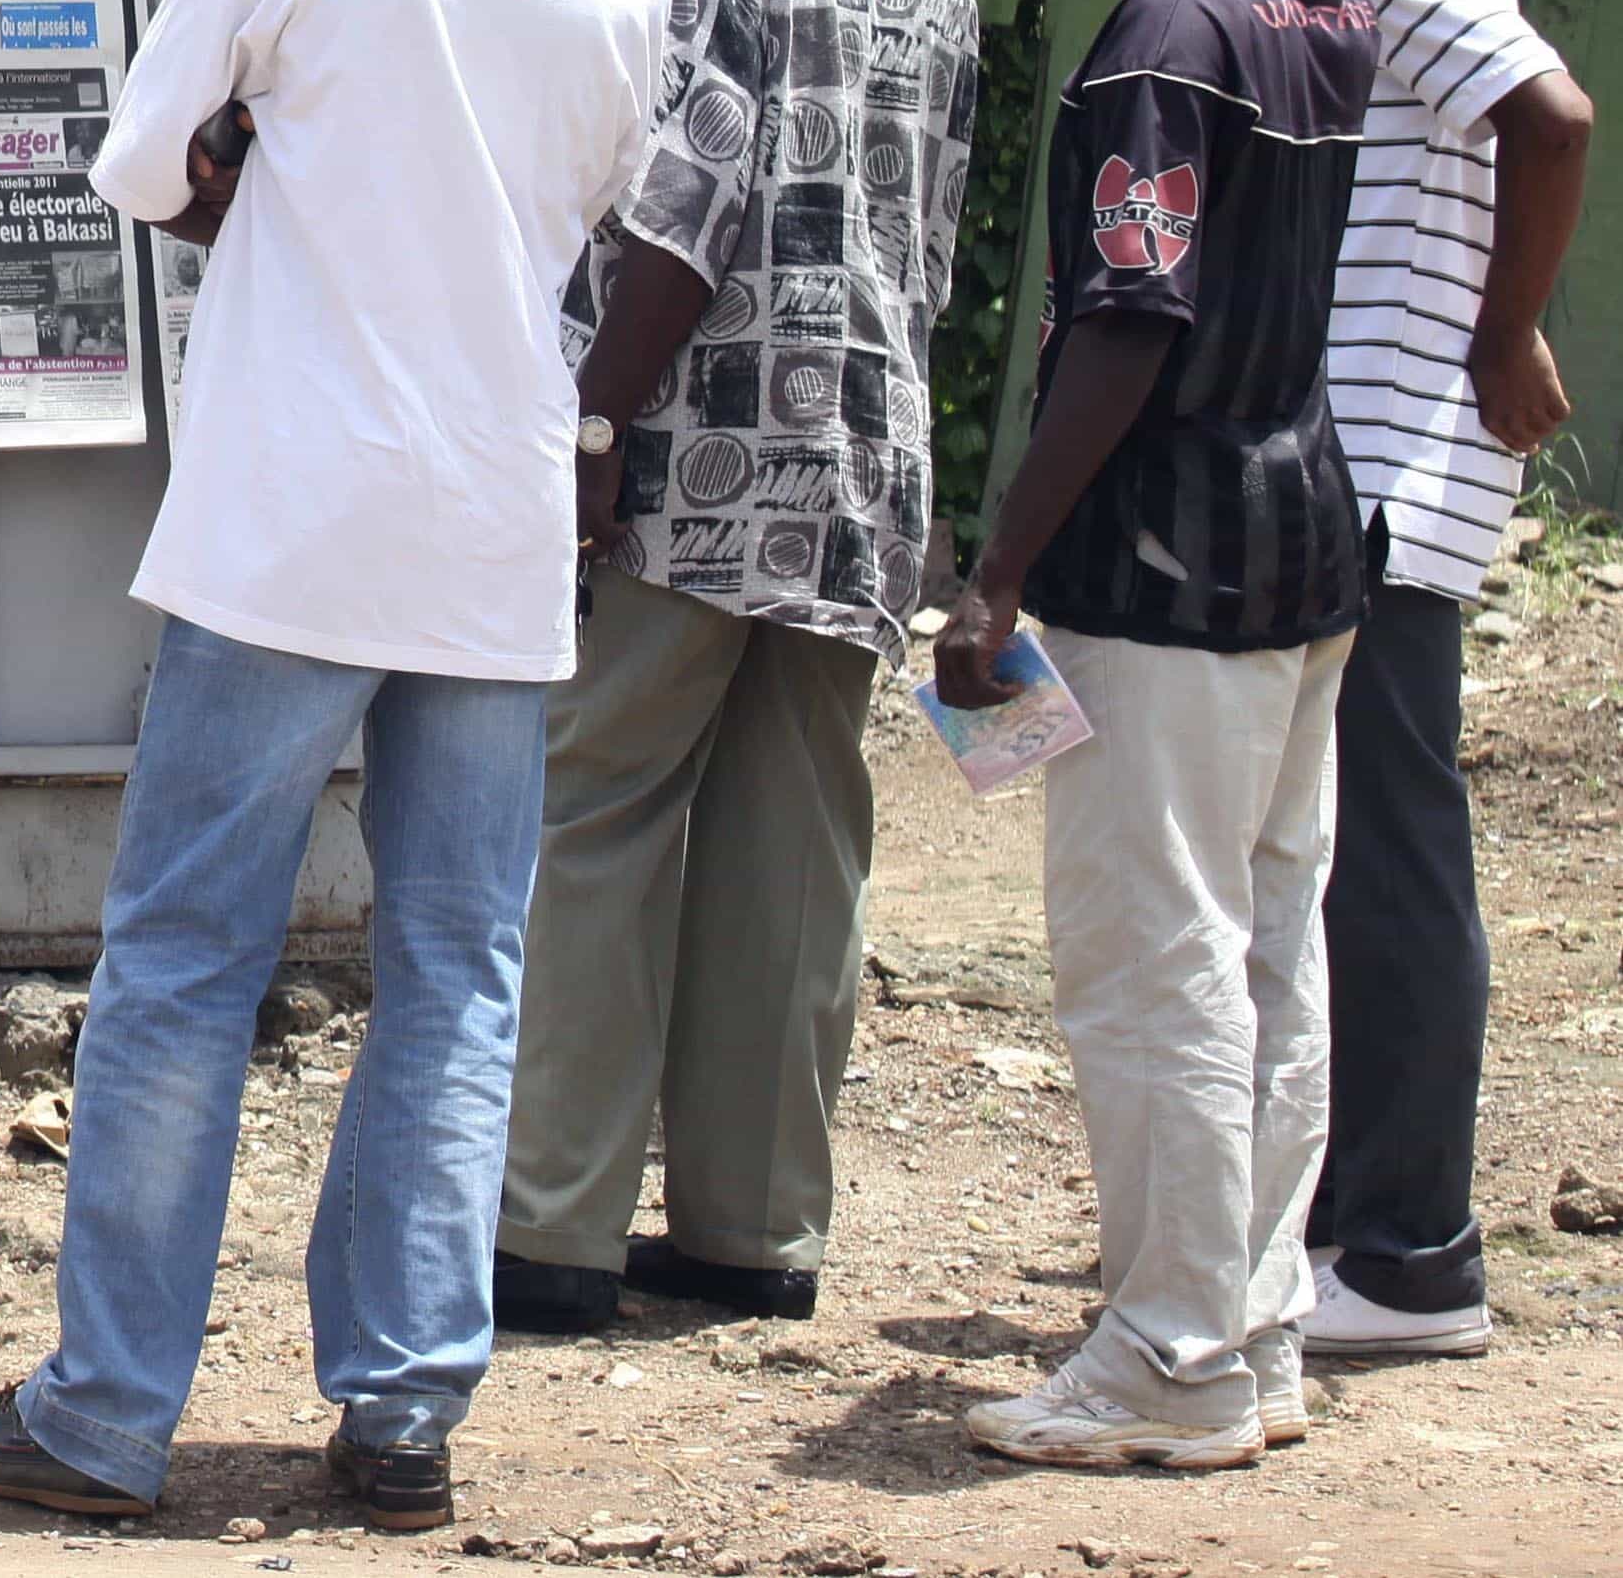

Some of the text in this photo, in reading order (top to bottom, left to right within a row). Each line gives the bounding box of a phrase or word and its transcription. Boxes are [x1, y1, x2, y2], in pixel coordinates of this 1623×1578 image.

[33, 176, 57, 189] 2011
[10, 191, 109, 220] électorale,
[27, 222, 39, 243] à
[44, 217, 114, 243] Bakassi
